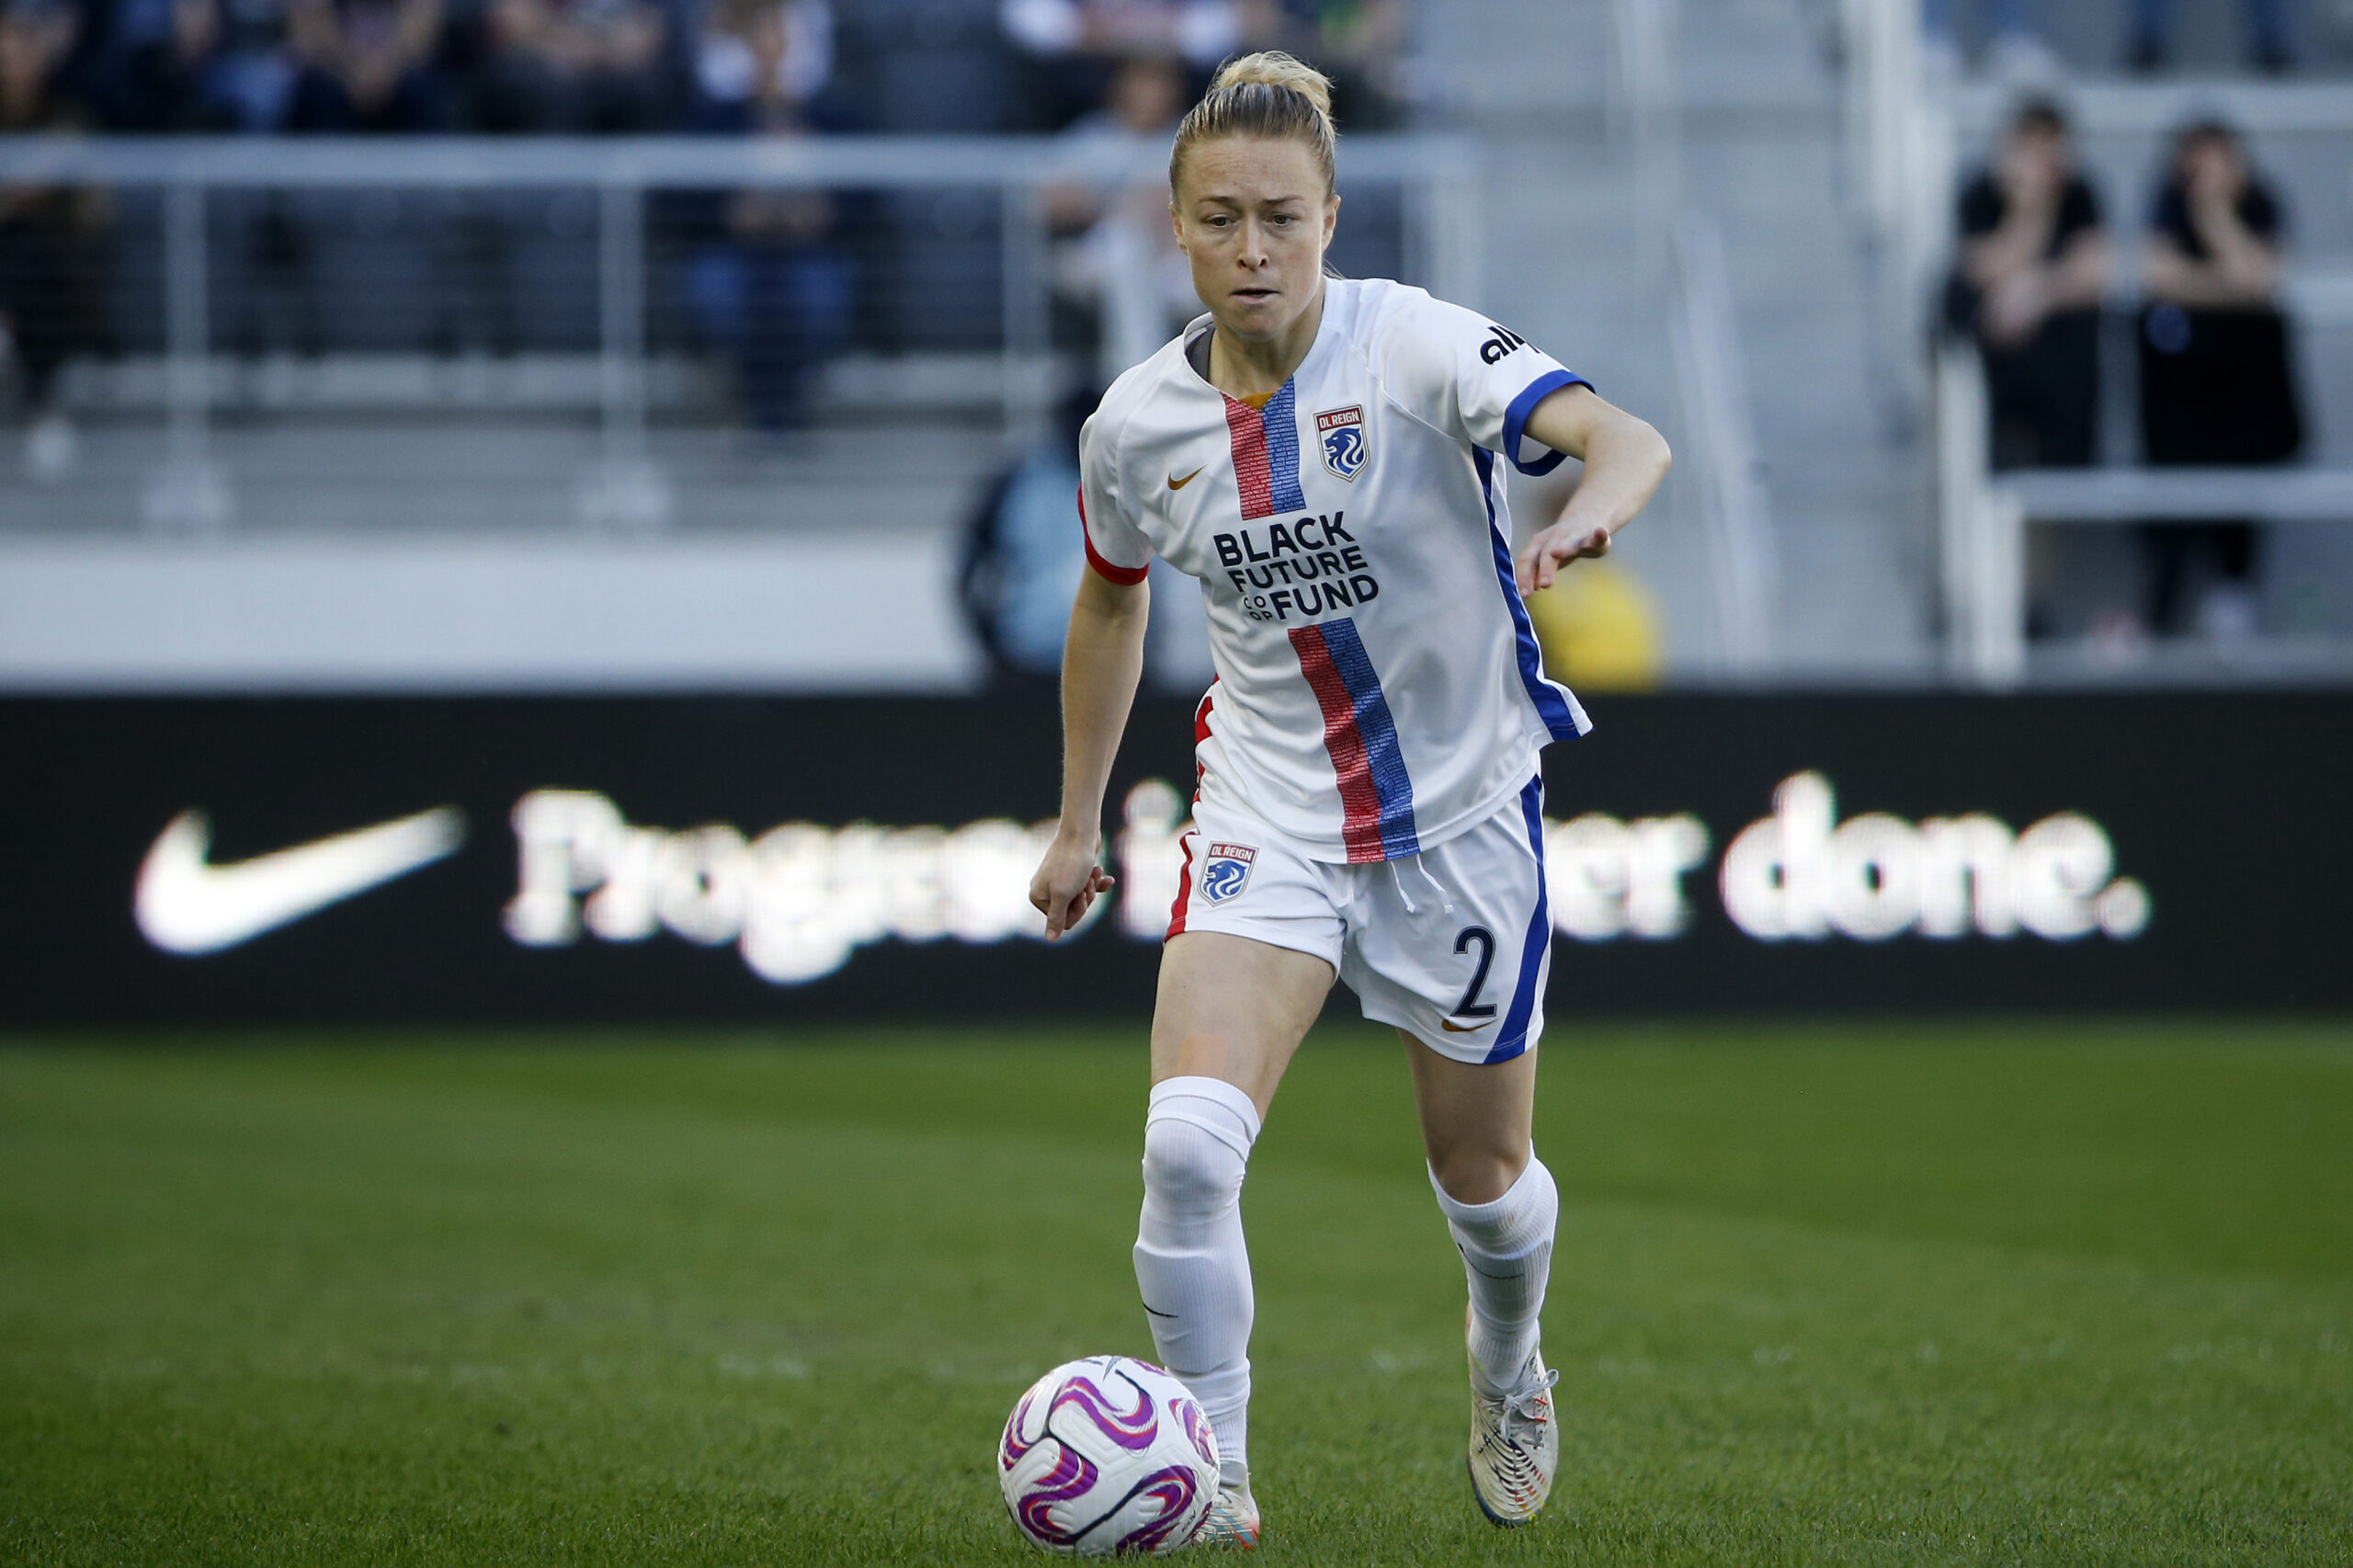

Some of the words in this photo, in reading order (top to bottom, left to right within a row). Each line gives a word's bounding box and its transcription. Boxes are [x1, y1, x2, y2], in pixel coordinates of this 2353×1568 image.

[1479, 324, 1540, 365] all
[1319, 416, 1332, 429] OL
[1332, 410, 1359, 426] REIGN
[1213, 511, 1356, 567] BLACK
[1227, 545, 1369, 593] FUTURE
[1269, 574, 1379, 620] FUND
[1211, 846, 1222, 856] OL
[1222, 846, 1253, 861] REIGN
[1719, 771, 2152, 941] done.
[1450, 925, 1497, 1017] 2
